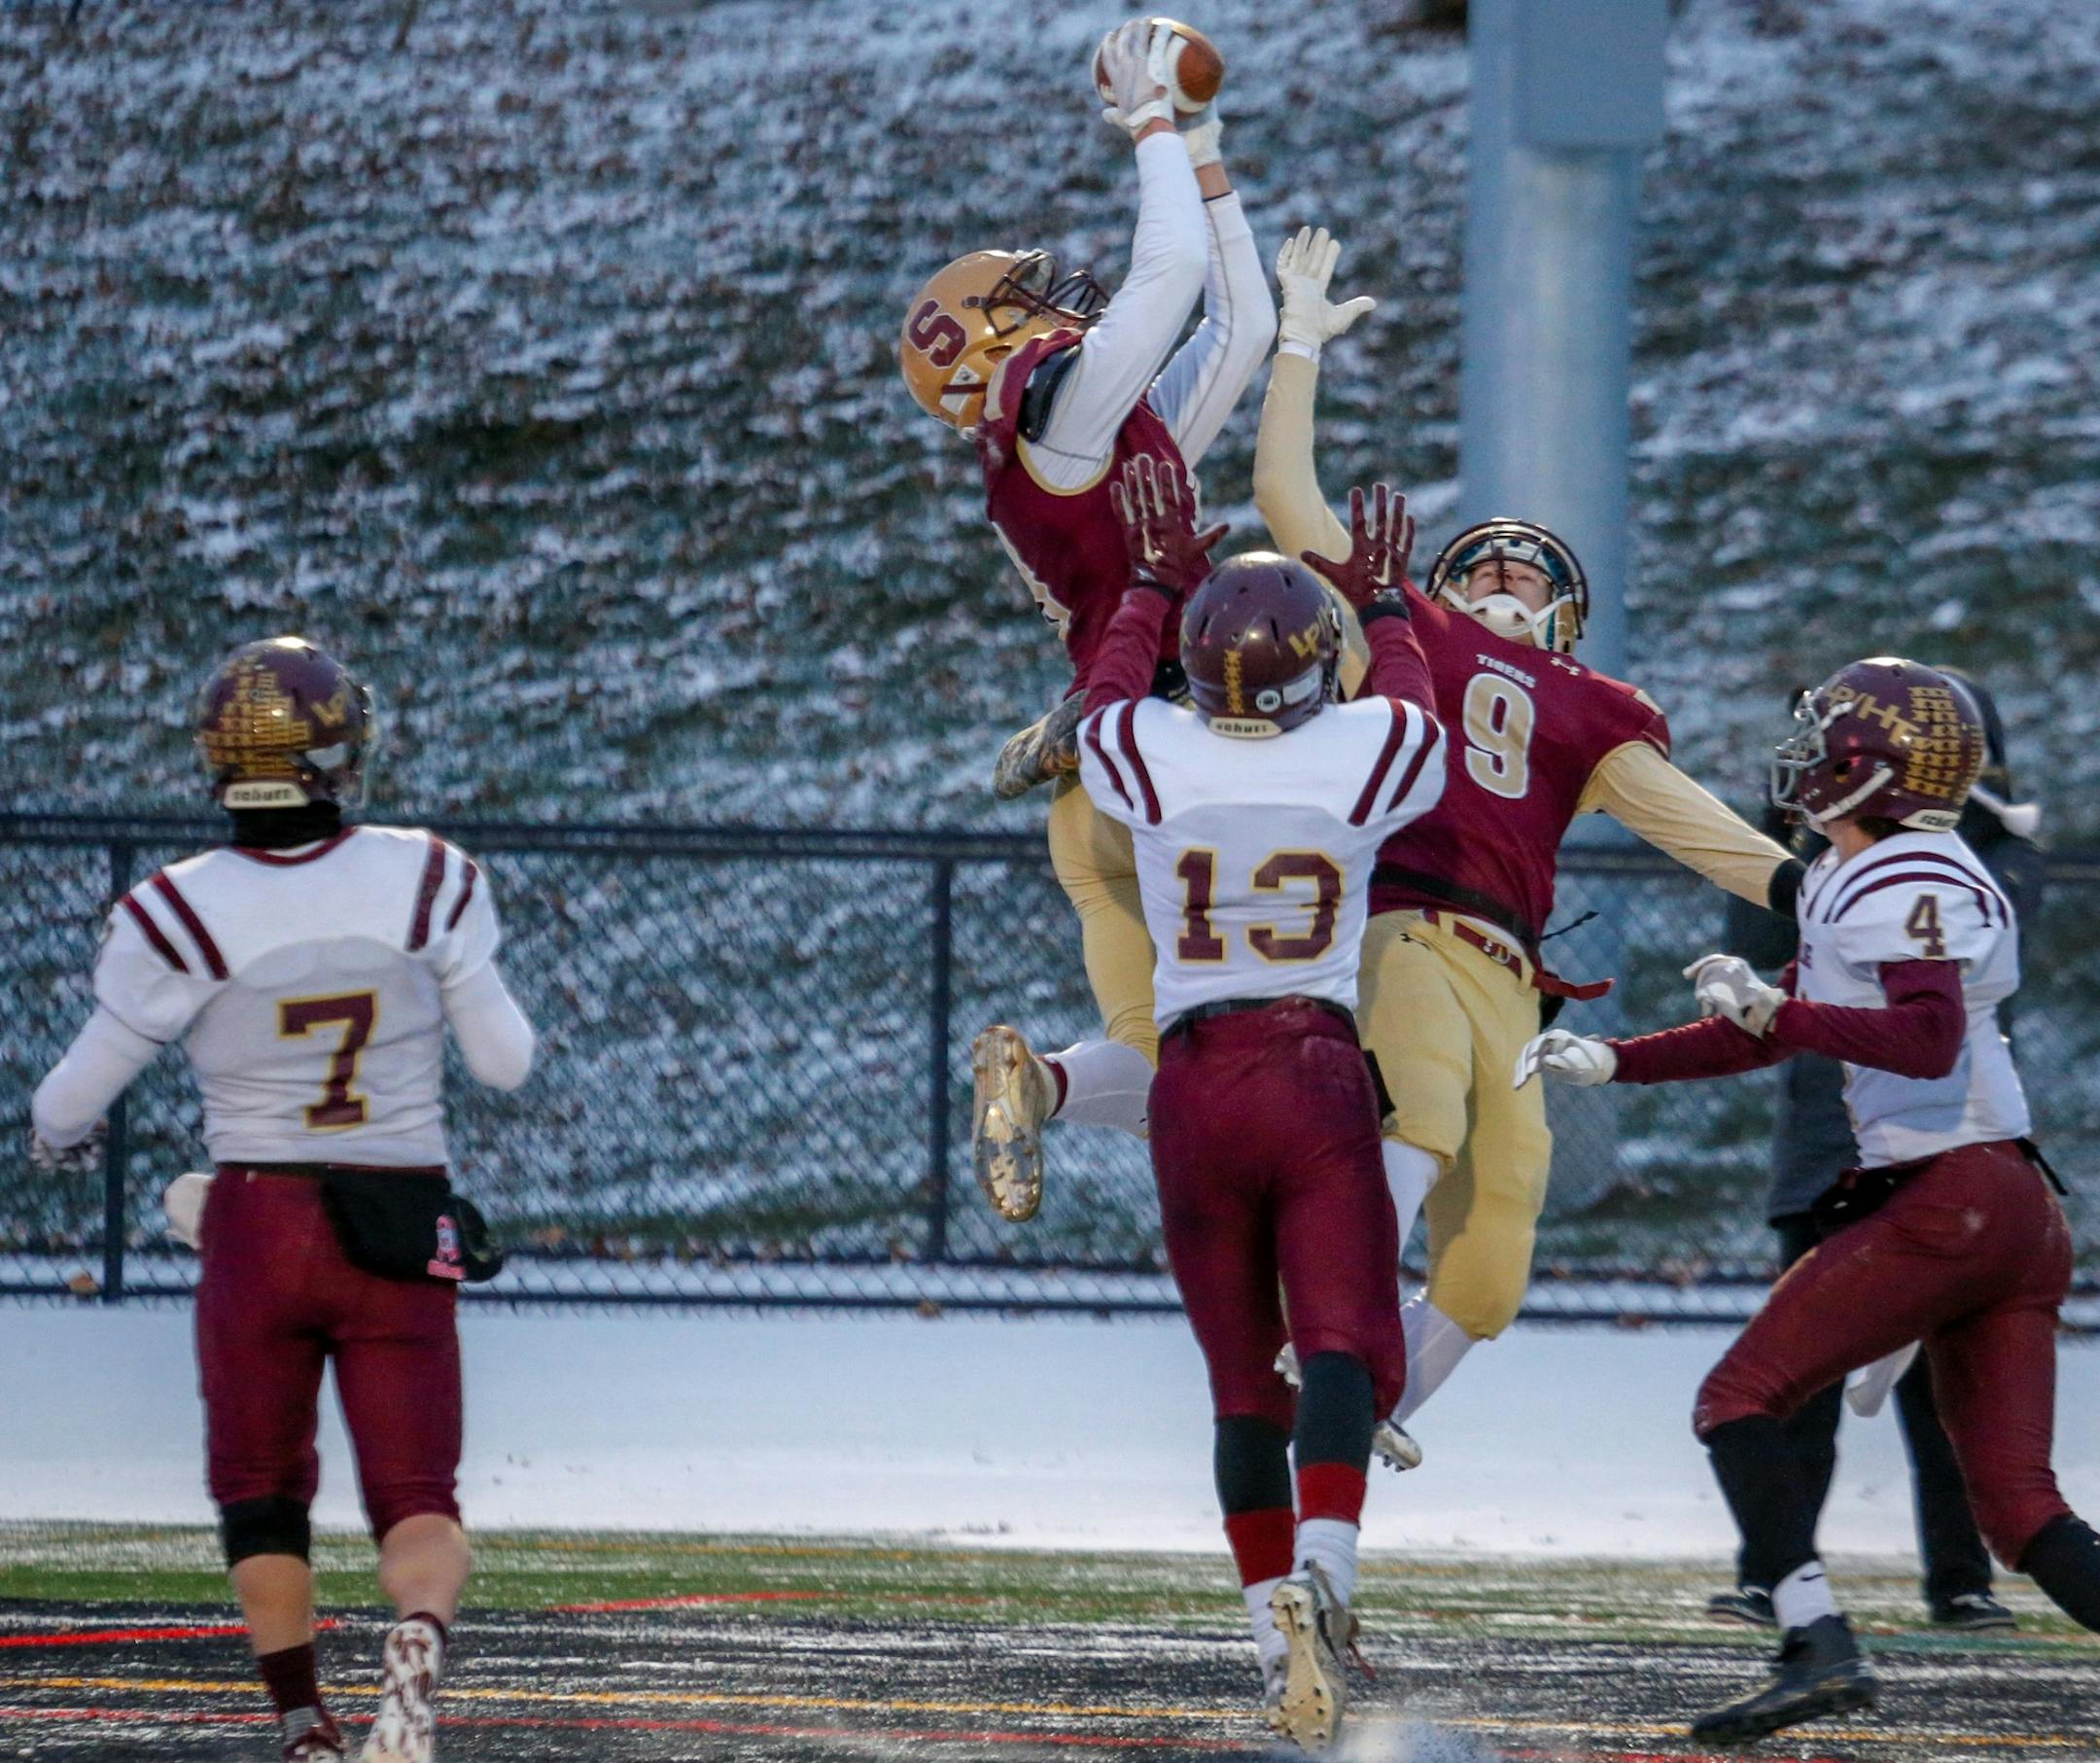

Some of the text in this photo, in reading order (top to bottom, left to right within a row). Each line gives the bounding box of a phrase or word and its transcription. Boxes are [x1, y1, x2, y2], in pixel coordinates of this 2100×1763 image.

[908, 298, 966, 369] S
[1475, 653, 1537, 688] TIGERS
[1462, 672, 1536, 800] 9
[1173, 845, 1346, 967] 13
[1904, 893, 1946, 959] 4
[275, 987, 379, 1133] 7
